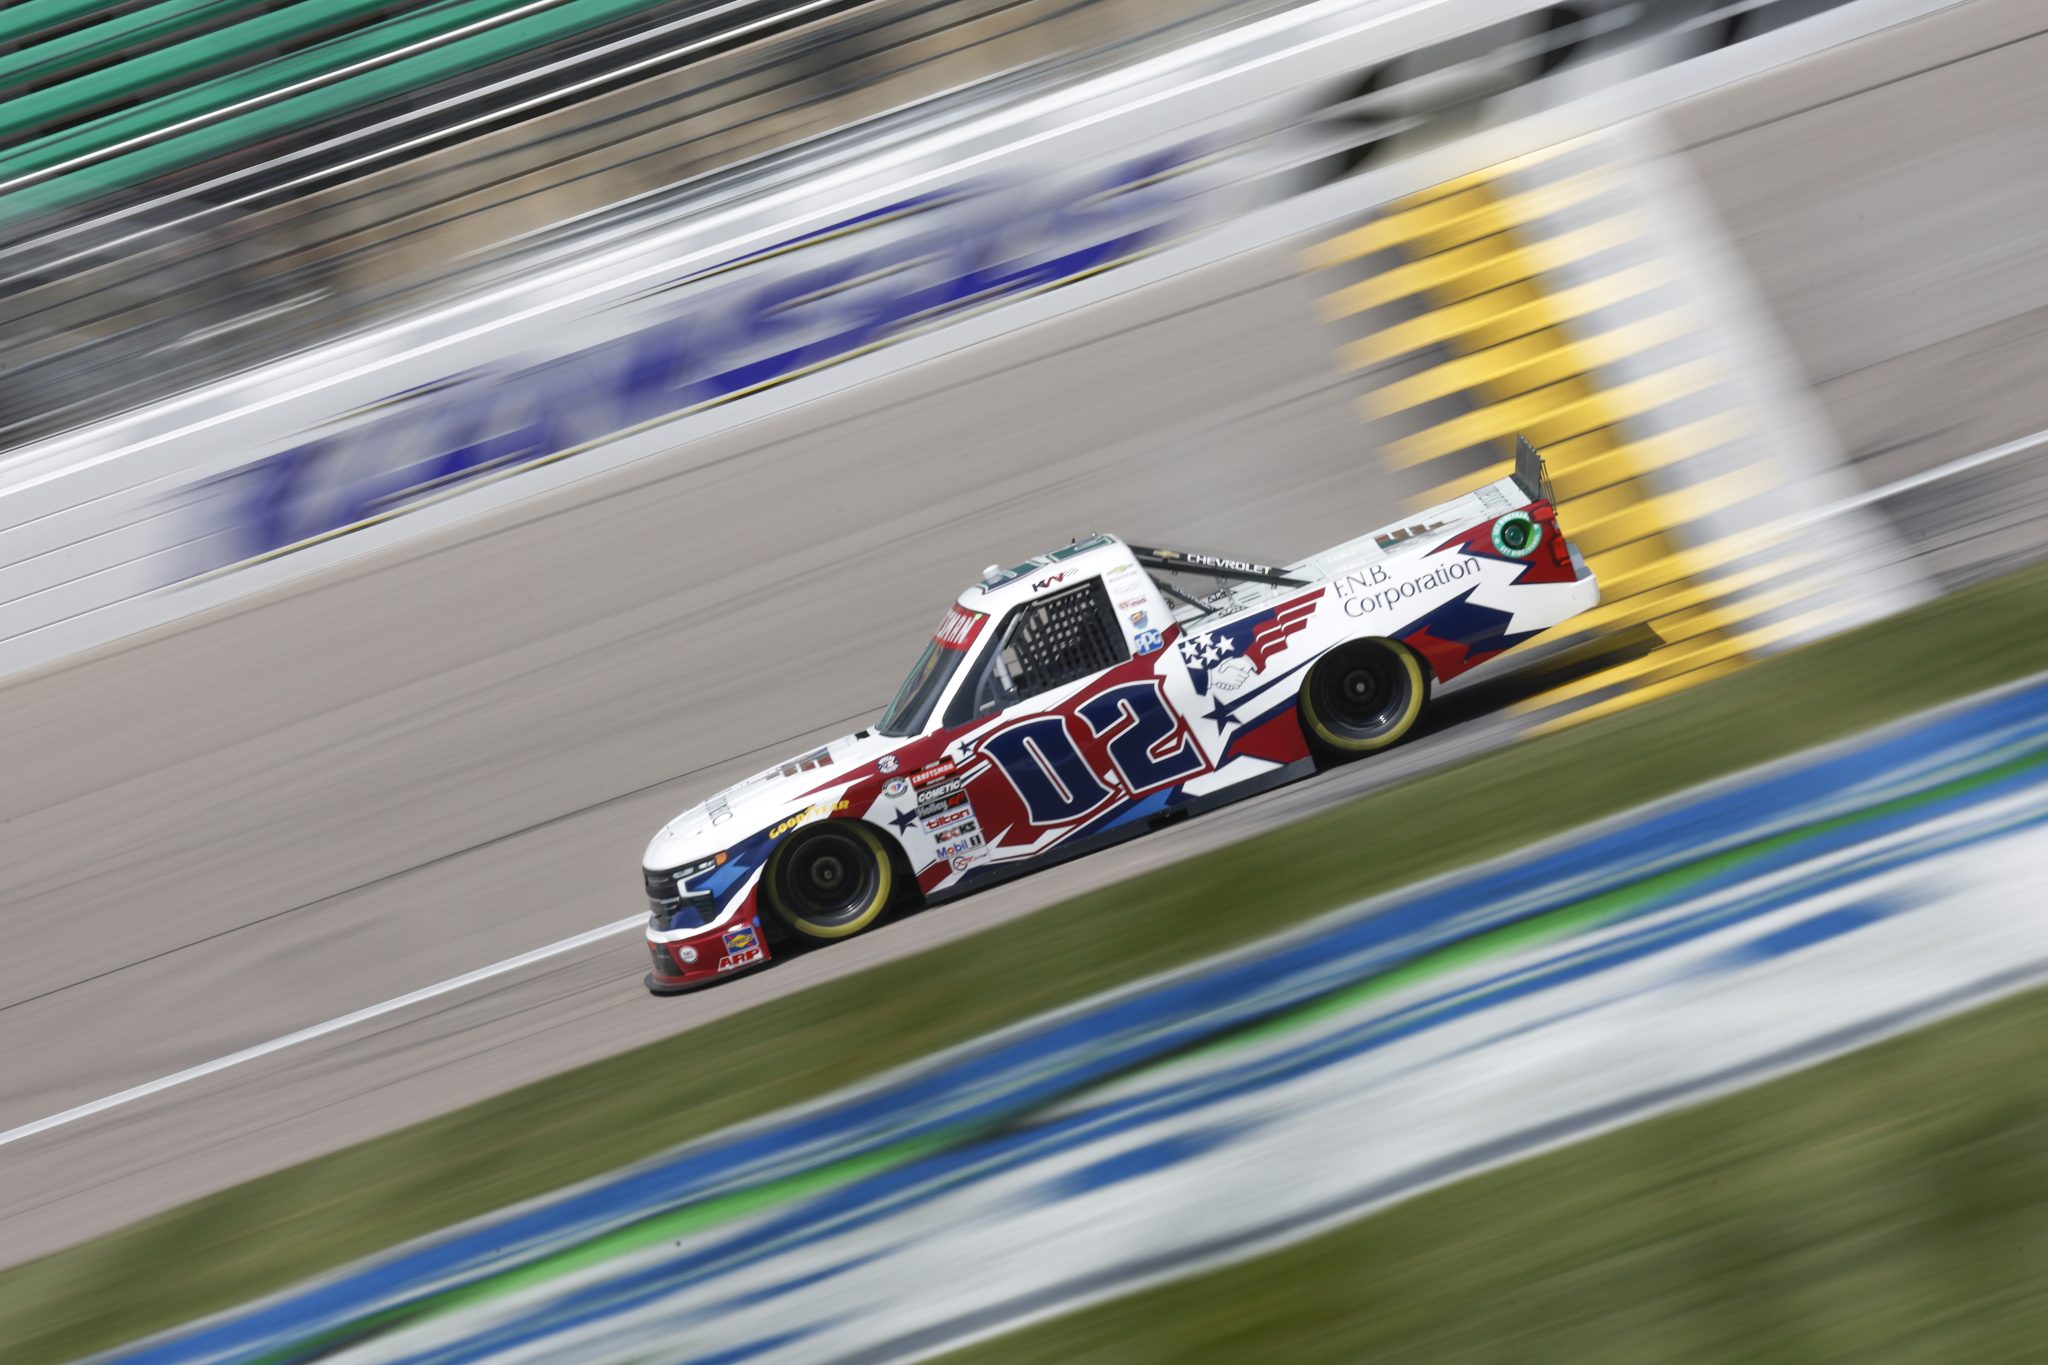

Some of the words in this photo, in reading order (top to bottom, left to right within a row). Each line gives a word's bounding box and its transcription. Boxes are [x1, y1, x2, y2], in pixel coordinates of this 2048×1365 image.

[1187, 553, 1272, 575] CHEVROLET
[1333, 564, 1392, 599] F.N.B.
[1344, 556, 1481, 618] Corporation
[1135, 629, 1162, 653] PPG
[976, 678, 1208, 827] 02
[918, 780, 961, 803] COMETIC
[768, 799, 851, 840] GOODYEAR
[926, 808, 971, 830] tilton
[936, 840, 969, 859] Mobil
[718, 949, 760, 971] ARP
